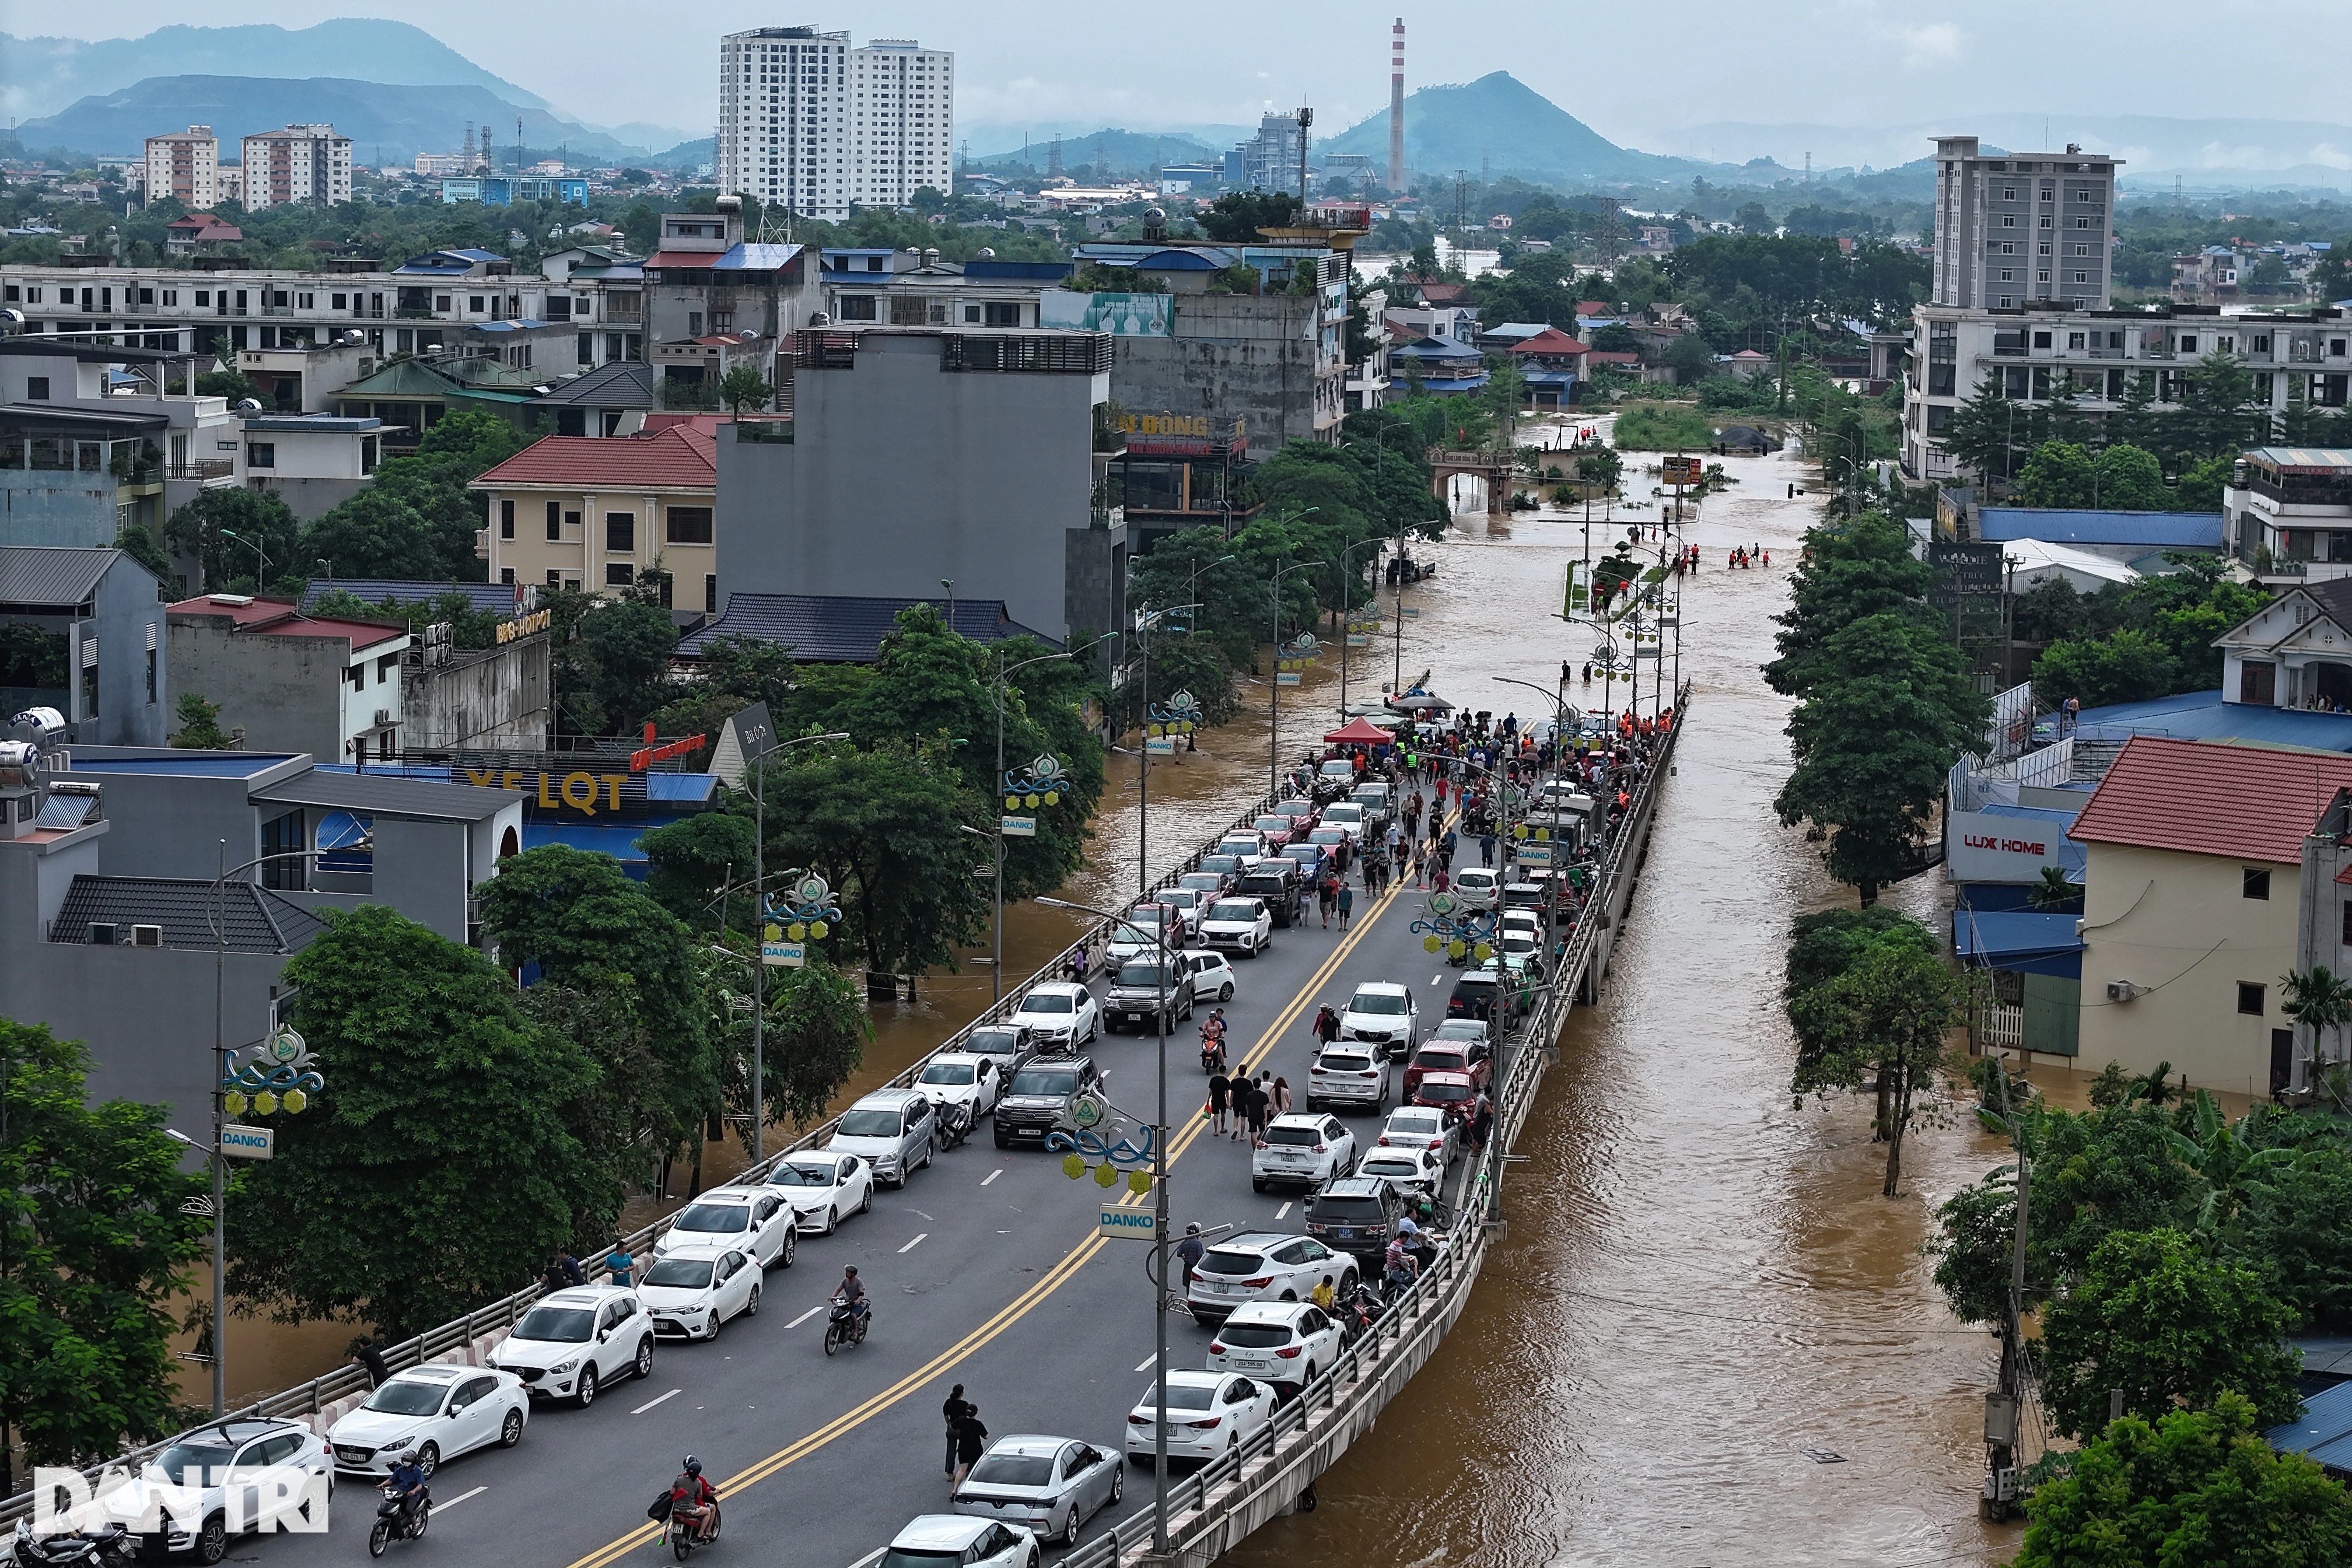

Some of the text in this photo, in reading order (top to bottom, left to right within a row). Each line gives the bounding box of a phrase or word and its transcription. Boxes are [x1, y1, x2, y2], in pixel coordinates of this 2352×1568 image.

[538, 771, 628, 817] LQT
[1003, 820, 1033, 831] DANKO
[1964, 834, 2045, 856] LUX HOME
[1518, 850, 1549, 860] DANKO
[764, 946, 802, 958] DANKO
[222, 1133, 267, 1148] DANKO
[1101, 1212, 1153, 1228] DANKO
